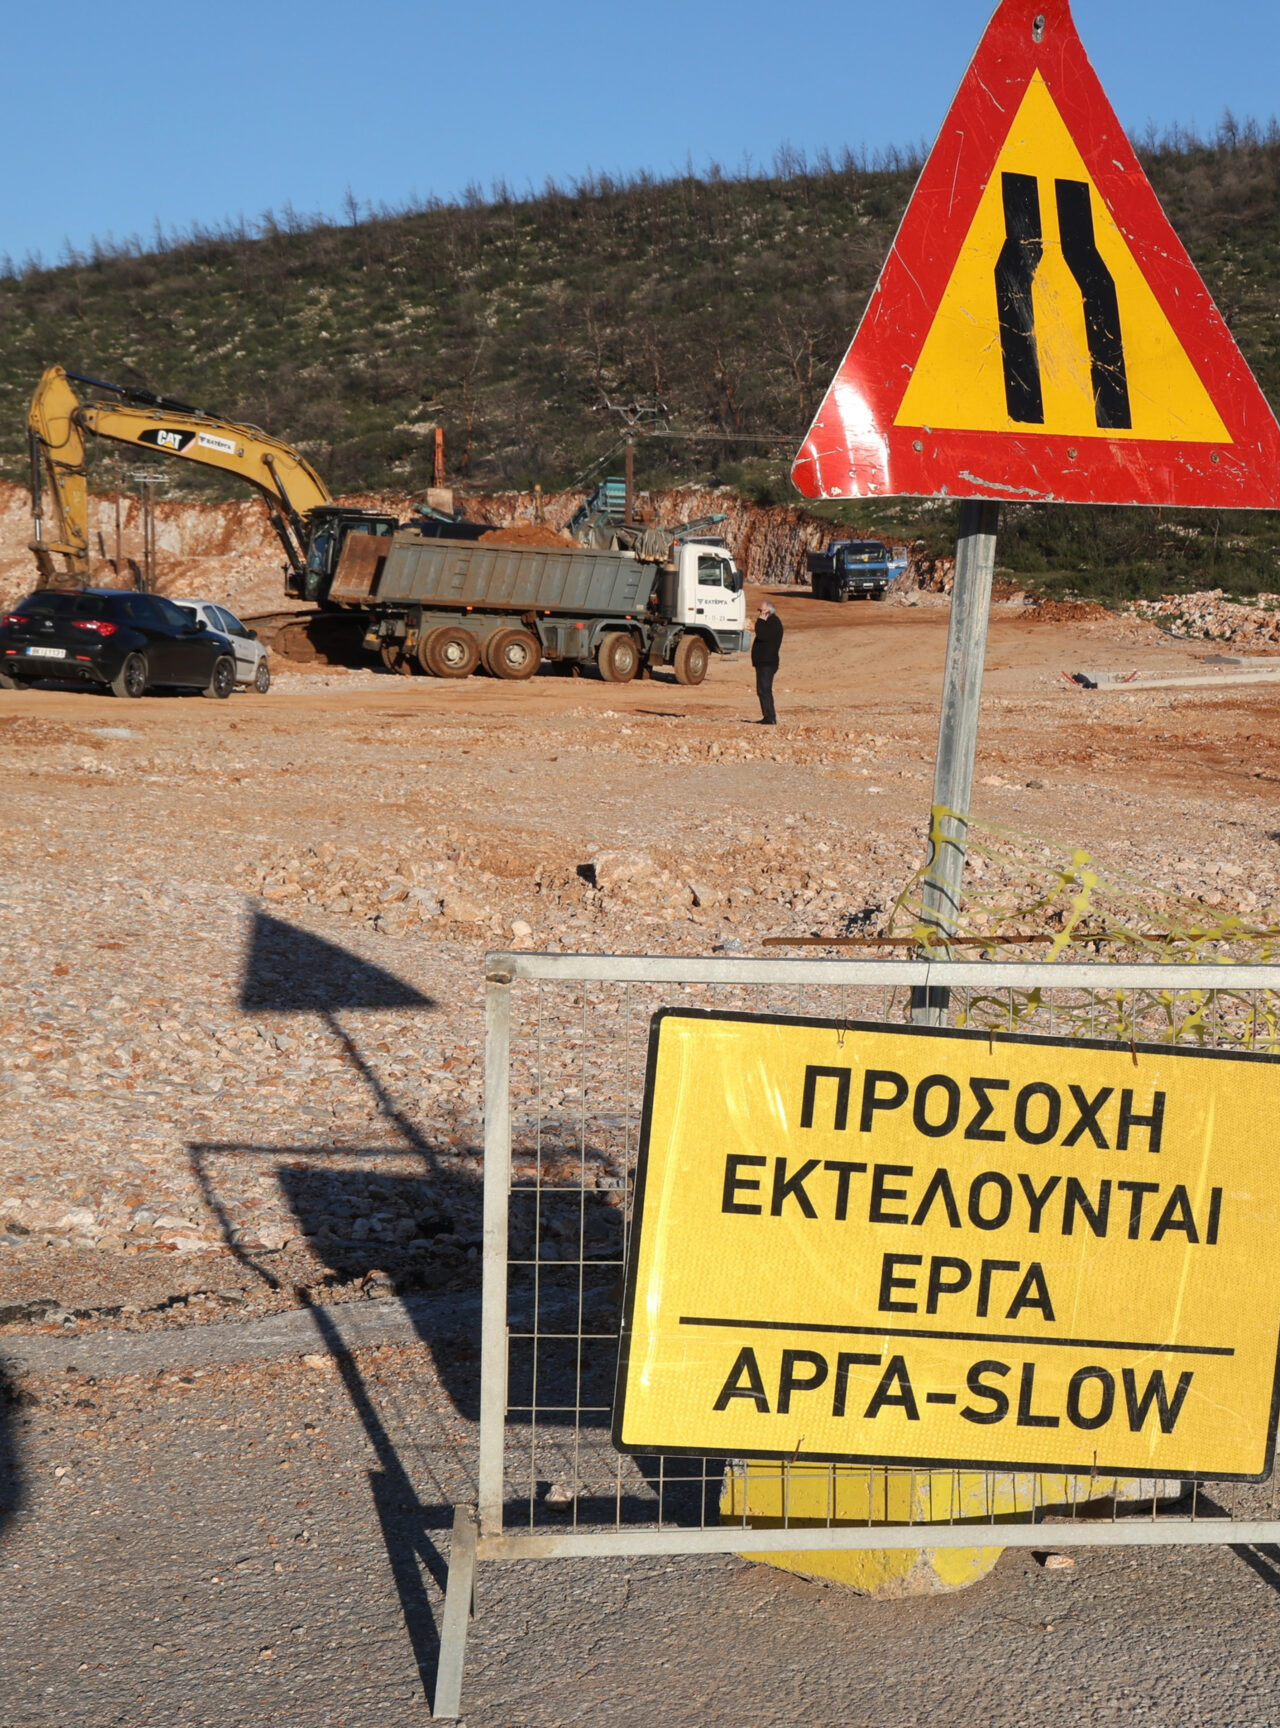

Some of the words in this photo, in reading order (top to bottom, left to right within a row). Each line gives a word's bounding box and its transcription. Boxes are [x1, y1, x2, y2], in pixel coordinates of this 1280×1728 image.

[157, 430, 182, 449] CAT
[800, 1064, 1166, 1154] ΠΡΟΣΟΧΗ
[721, 1153, 1223, 1245] ΕΚΤΕΛΟΥΝΤΑΙ
[878, 1252, 1056, 1322] ΕΡΓΑ
[712, 1347, 1194, 1434] ΑΡΓΑ-SLOW
